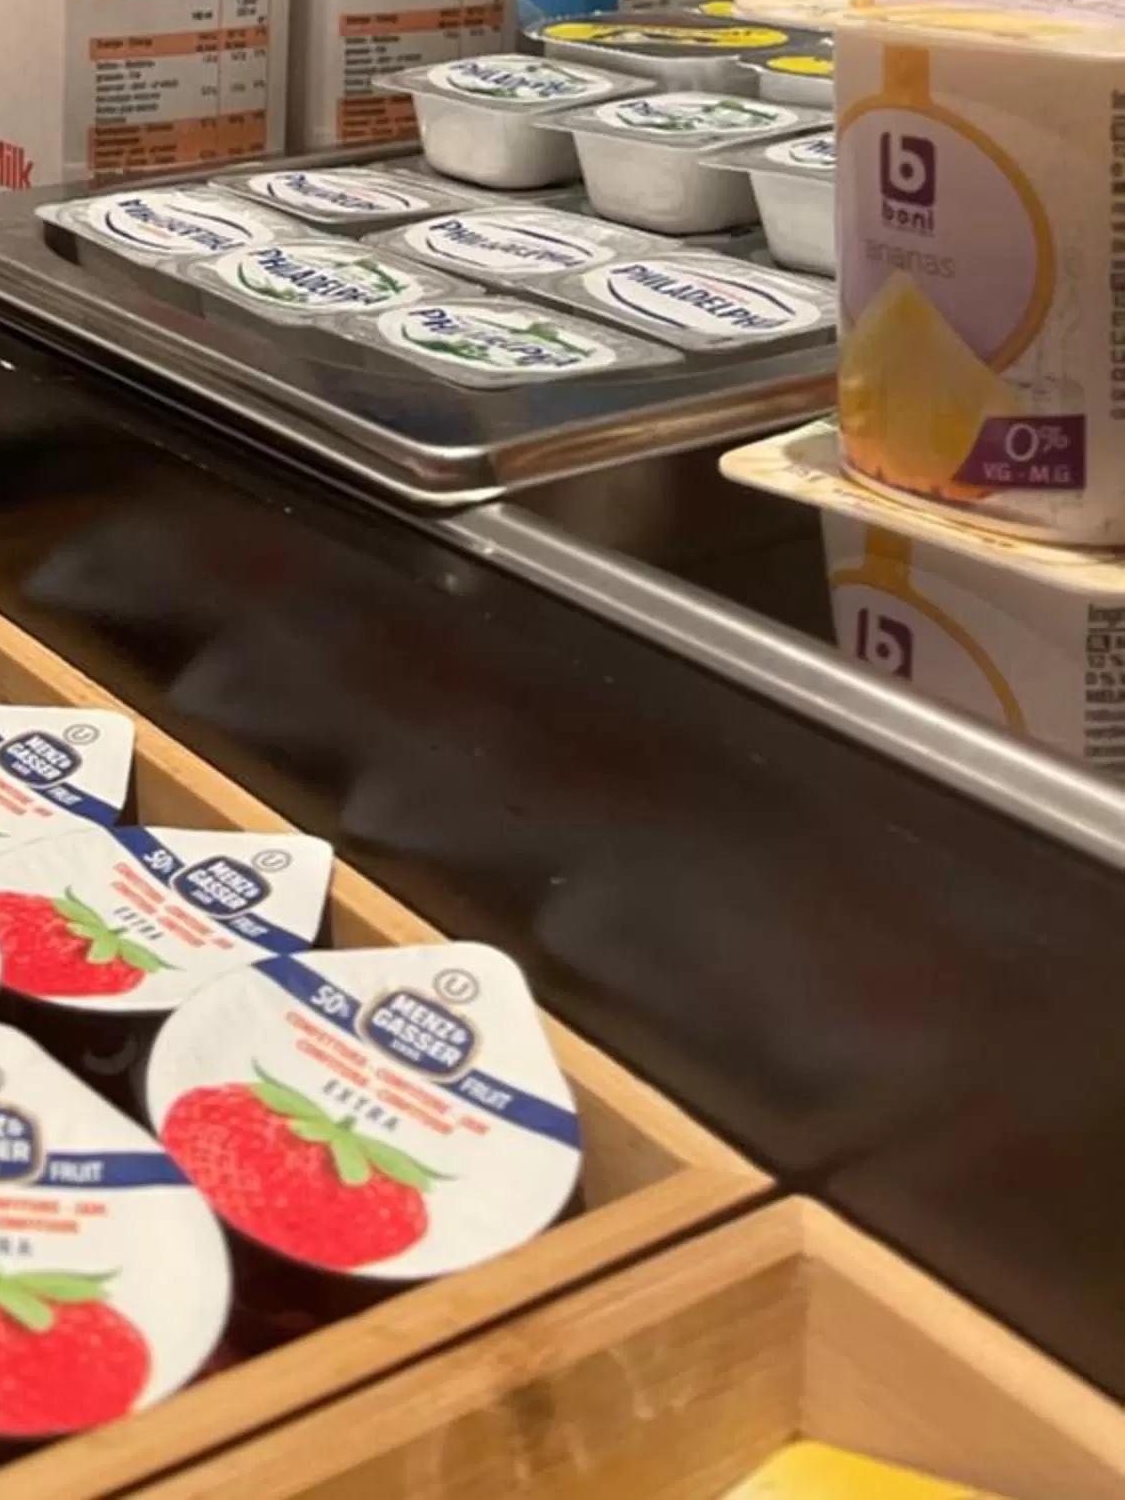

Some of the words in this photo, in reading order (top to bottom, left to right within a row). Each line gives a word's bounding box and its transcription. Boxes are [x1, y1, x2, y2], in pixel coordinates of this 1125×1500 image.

[882, 199, 935, 233] boni
[372, 1007, 463, 1067] GASSER
[323, 1078, 402, 1132] EXTRA
[459, 1076, 513, 1111] FRUIT
[48, 1160, 105, 1183] FRUIT
